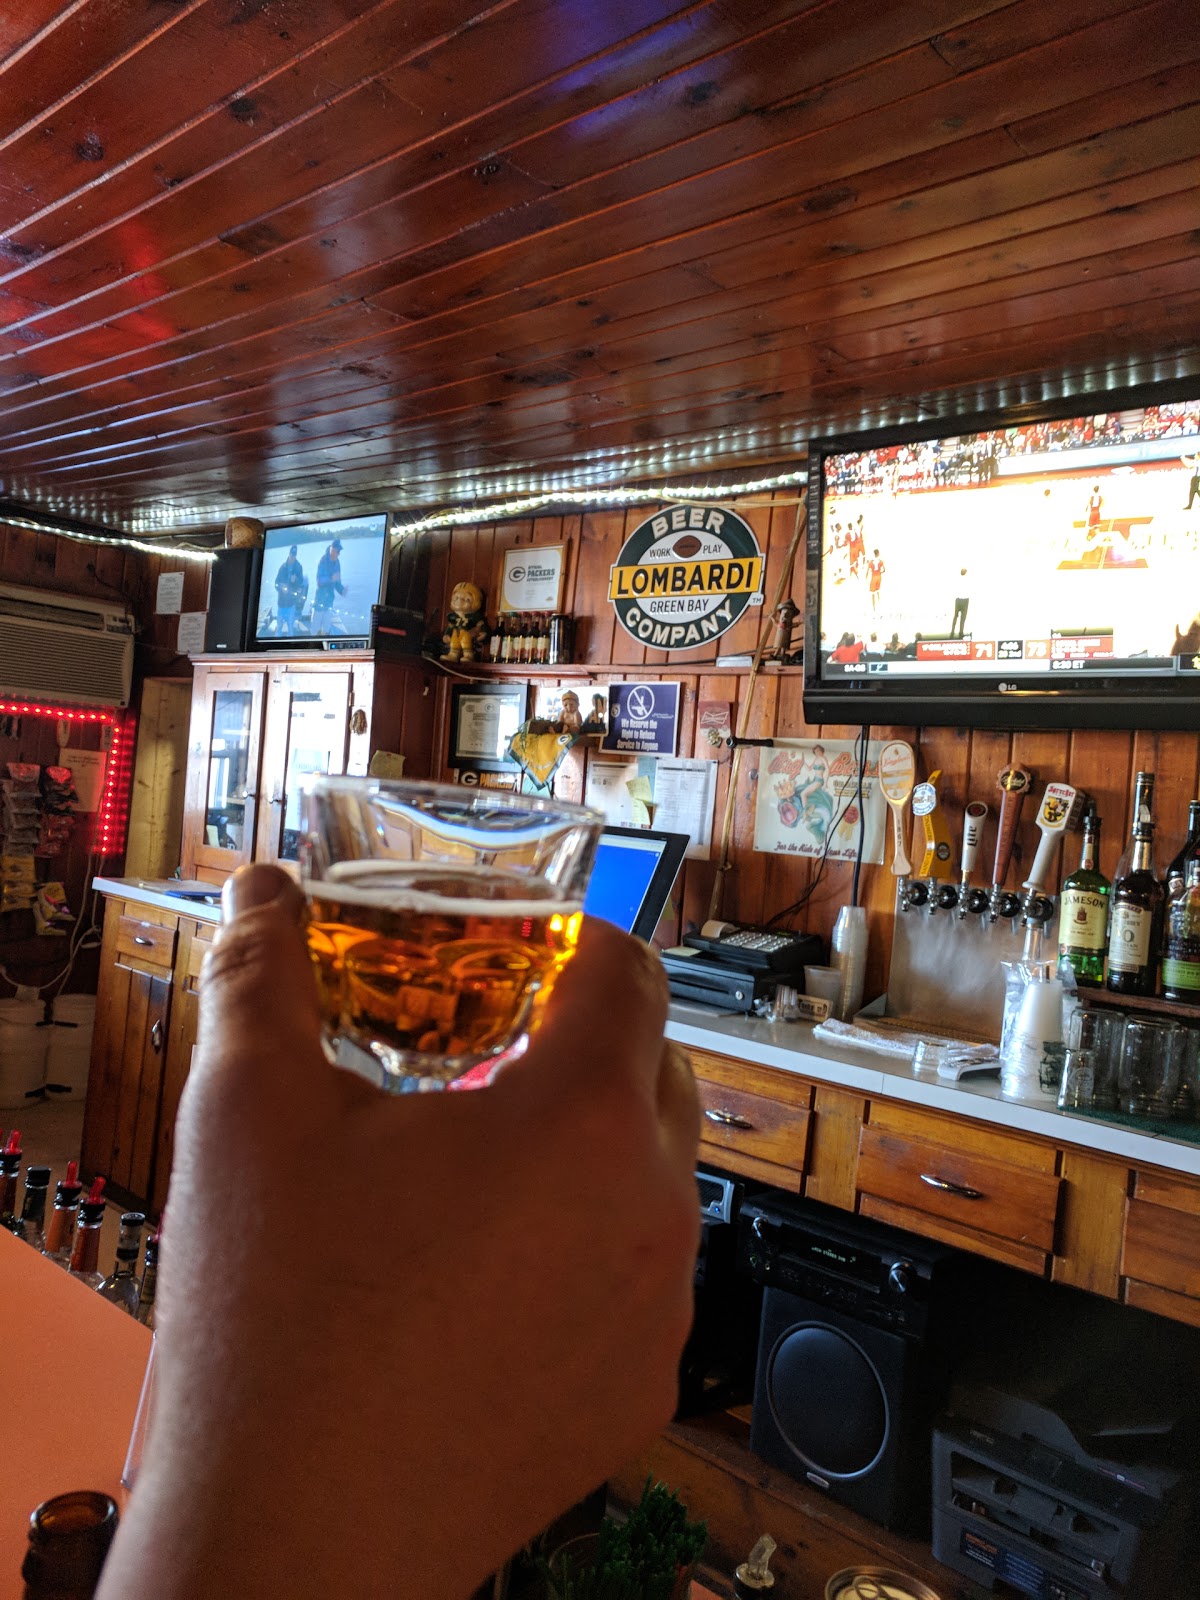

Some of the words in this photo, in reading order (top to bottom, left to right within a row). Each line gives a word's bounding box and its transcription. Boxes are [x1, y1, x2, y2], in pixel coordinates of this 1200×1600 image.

[651, 508, 725, 539] BEER
[650, 547, 671, 557] WORK
[703, 544, 722, 554] PLAY
[527, 568, 555, 577] PACKERS
[617, 561, 754, 595] LOMBARDI
[650, 600, 684, 613] GREEN
[687, 598, 709, 612] BAY
[626, 600, 733, 646] COMPANY
[975, 643, 993, 658] 71
[621, 718, 629, 728] We
[630, 719, 649, 729] Reserve
[649, 719, 658, 729] the
[621, 729, 633, 740] Right
[634, 729, 639, 739] to
[639, 730, 656, 740] Refuse
[616, 740, 635, 750] Service
[635, 740, 641, 750] to
[641, 741, 659, 751] Anyone
[767, 752, 805, 780] Big
[967, 825, 977, 848] Lite
[774, 841, 787, 851] For
[788, 842, 798, 852] the
[798, 843, 813, 853] Ride
[814, 845, 823, 856] of
[1064, 895, 1105, 910] JAMESON
